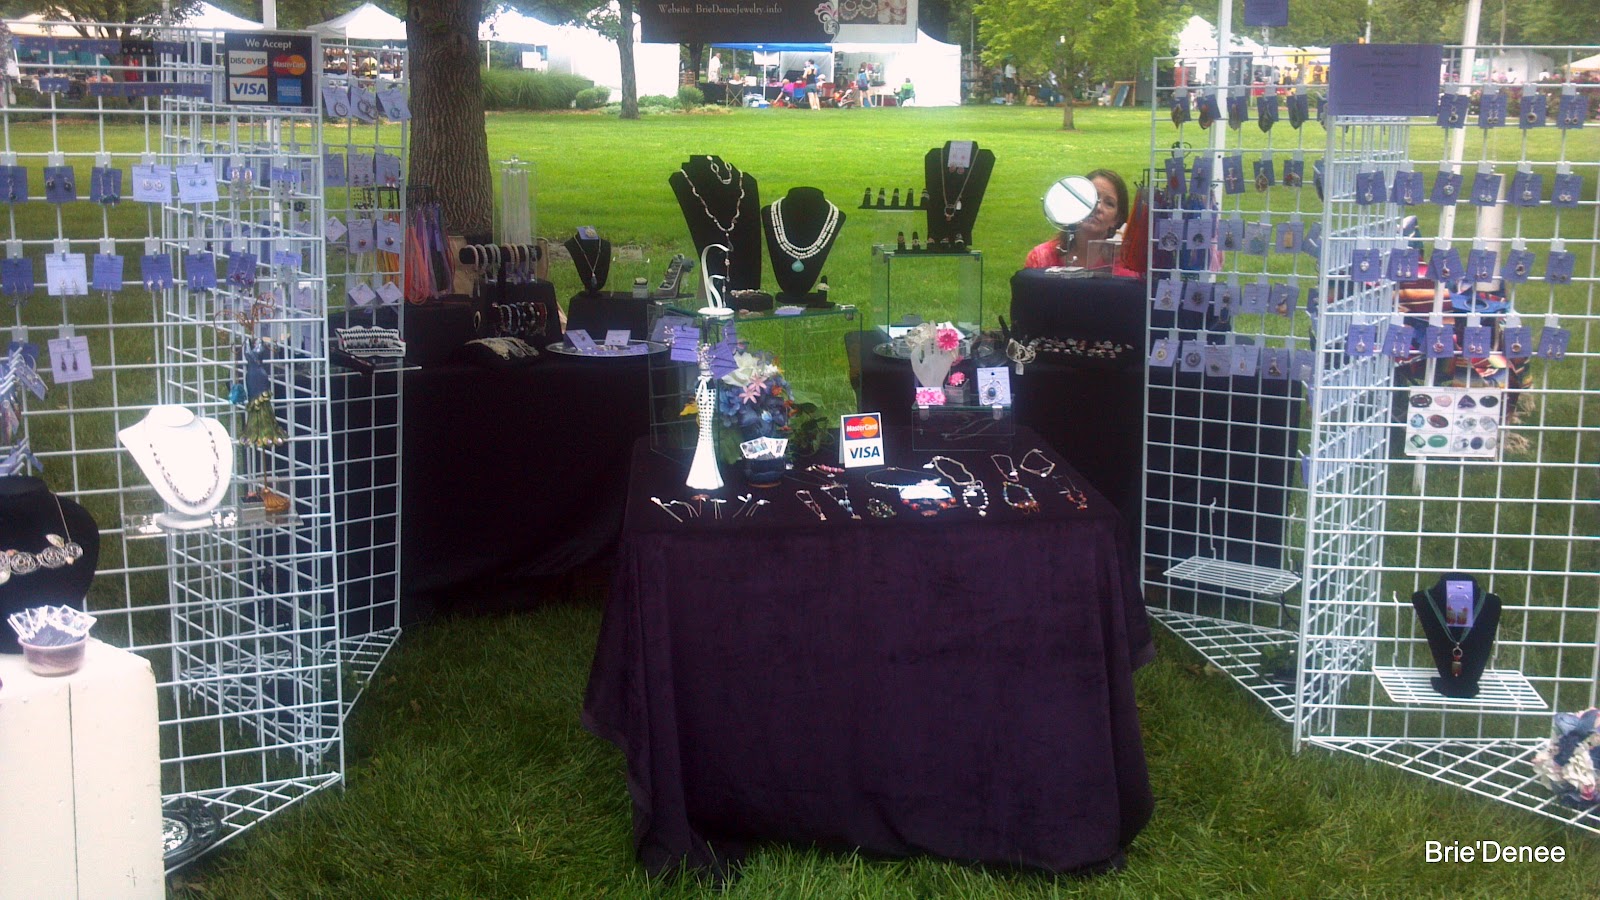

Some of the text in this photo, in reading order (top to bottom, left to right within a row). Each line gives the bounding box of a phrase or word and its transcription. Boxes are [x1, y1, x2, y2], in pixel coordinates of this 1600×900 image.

[658, 2, 782, 15] Website: BrieDeneeJewelry.info
[245, 38, 292, 51] We Accept
[230, 57, 266, 65] DISCOVER
[232, 82, 267, 96] VISA
[849, 445, 880, 459] VISA
